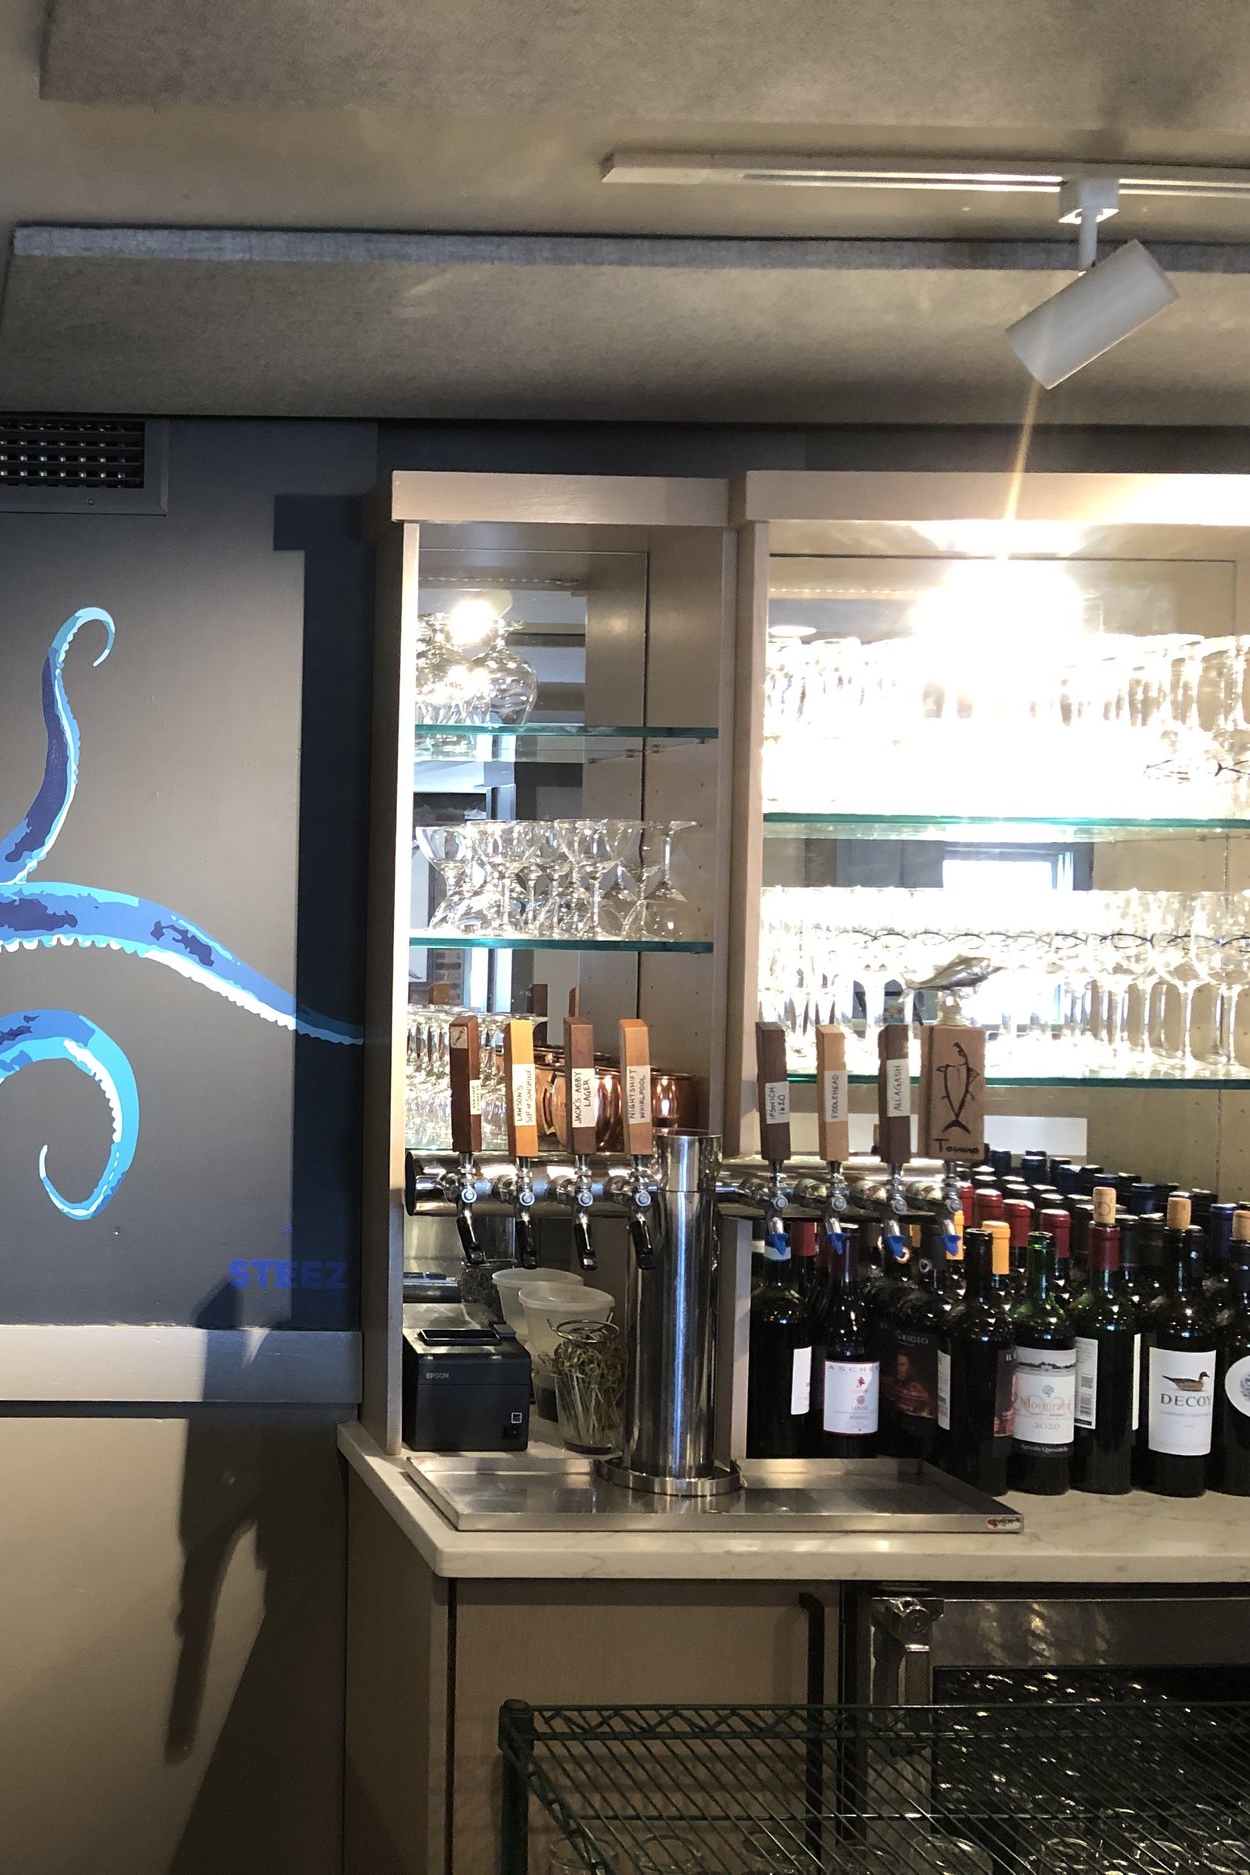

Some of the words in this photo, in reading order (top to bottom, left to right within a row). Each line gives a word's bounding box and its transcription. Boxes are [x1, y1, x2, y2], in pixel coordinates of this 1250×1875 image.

[573, 1071, 582, 1093] ABBY
[583, 1078, 592, 1108] LAGER
[638, 1075, 646, 1119] WHIRLPOOL
[830, 1074, 839, 1119] FIDDLEHEAD
[893, 1065, 902, 1112] ALLAGASH
[573, 1097, 582, 1124] JACK'S
[768, 1086, 776, 1120] IPSWICH
[777, 1094, 786, 1115] 1620
[228, 1258, 350, 1290] STEEZ
[1160, 1393, 1212, 1408] DECOY
[1033, 1421, 1061, 1431] 2020
